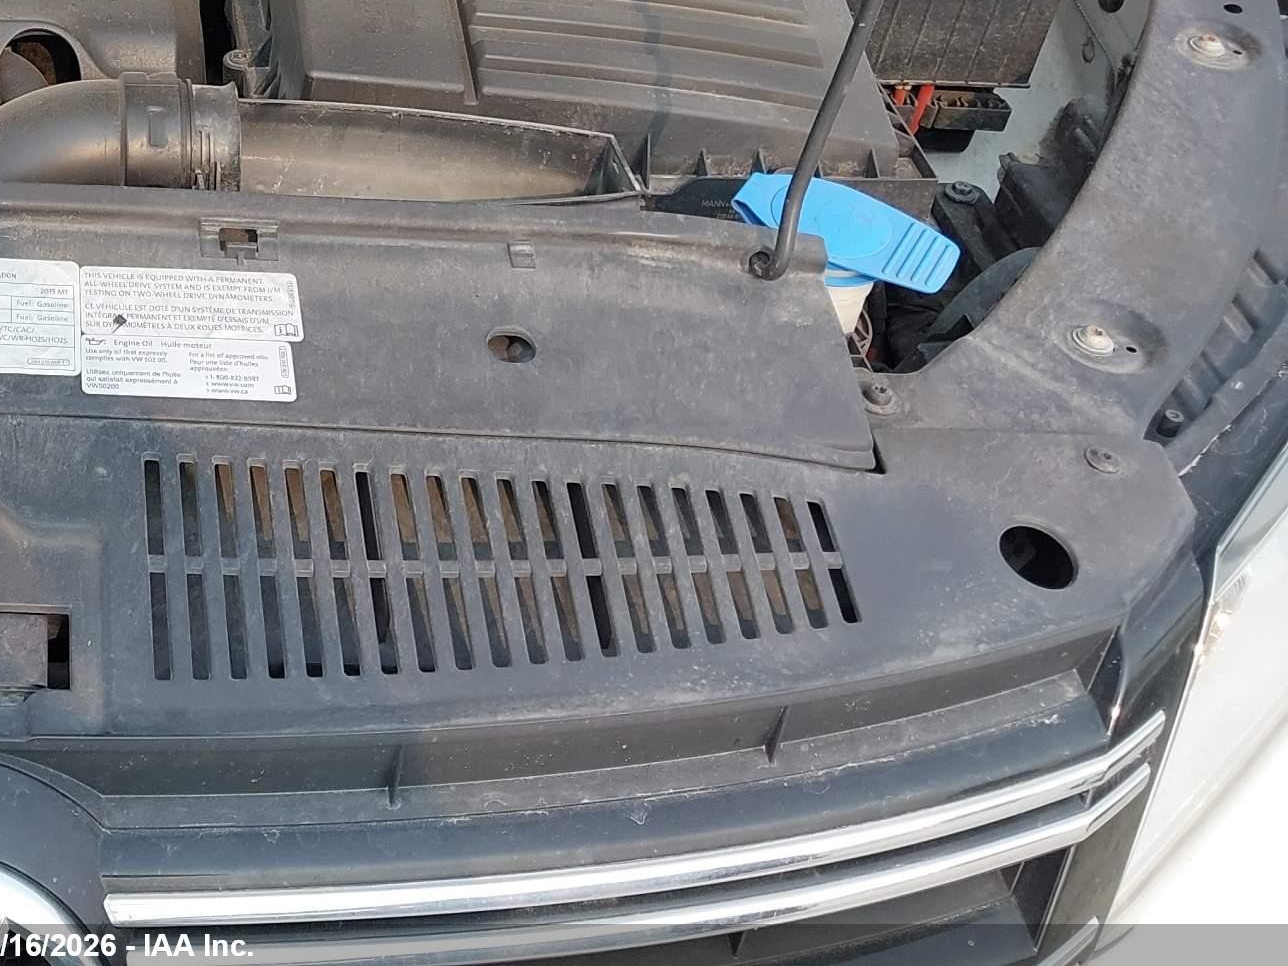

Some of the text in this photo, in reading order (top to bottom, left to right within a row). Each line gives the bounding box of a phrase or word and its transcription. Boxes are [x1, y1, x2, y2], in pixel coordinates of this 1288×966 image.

[144, 274, 184, 282] EQUIPPED
[211, 284, 241, 292] EXEMPT
[133, 291, 180, 299] TWO-WHEEL
[85, 311, 128, 320] INTÉGRA
[113, 339, 140, 348] Engine
[182, 341, 212, 349] moteur
